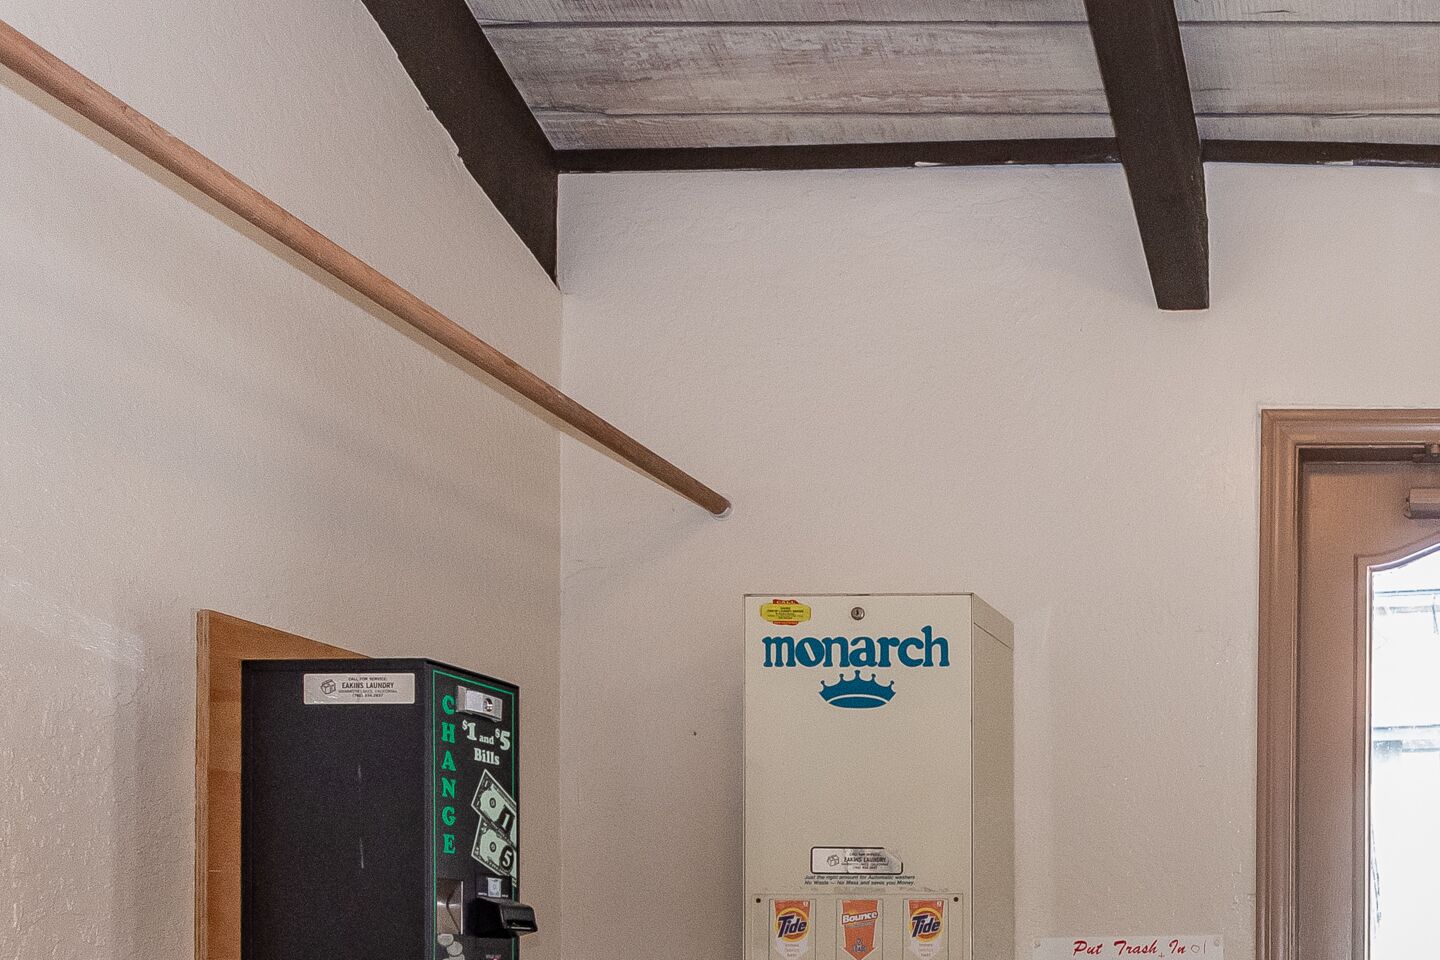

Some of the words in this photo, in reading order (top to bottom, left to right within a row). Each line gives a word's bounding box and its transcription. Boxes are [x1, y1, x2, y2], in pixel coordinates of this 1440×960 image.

[761, 625, 950, 668] monarch
[462, 719, 477, 741] $1
[479, 735, 495, 745] and
[495, 728, 511, 751] $5
[474, 747, 500, 765] Bills
[441, 694, 457, 854] CHANGE
[778, 914, 807, 938] Tide
[843, 911, 878, 924] Bounce
[912, 914, 941, 938] Tide
[1073, 940, 1103, 956] Put
[1113, 939, 1158, 955] Trash
[1169, 939, 1186, 954] In
